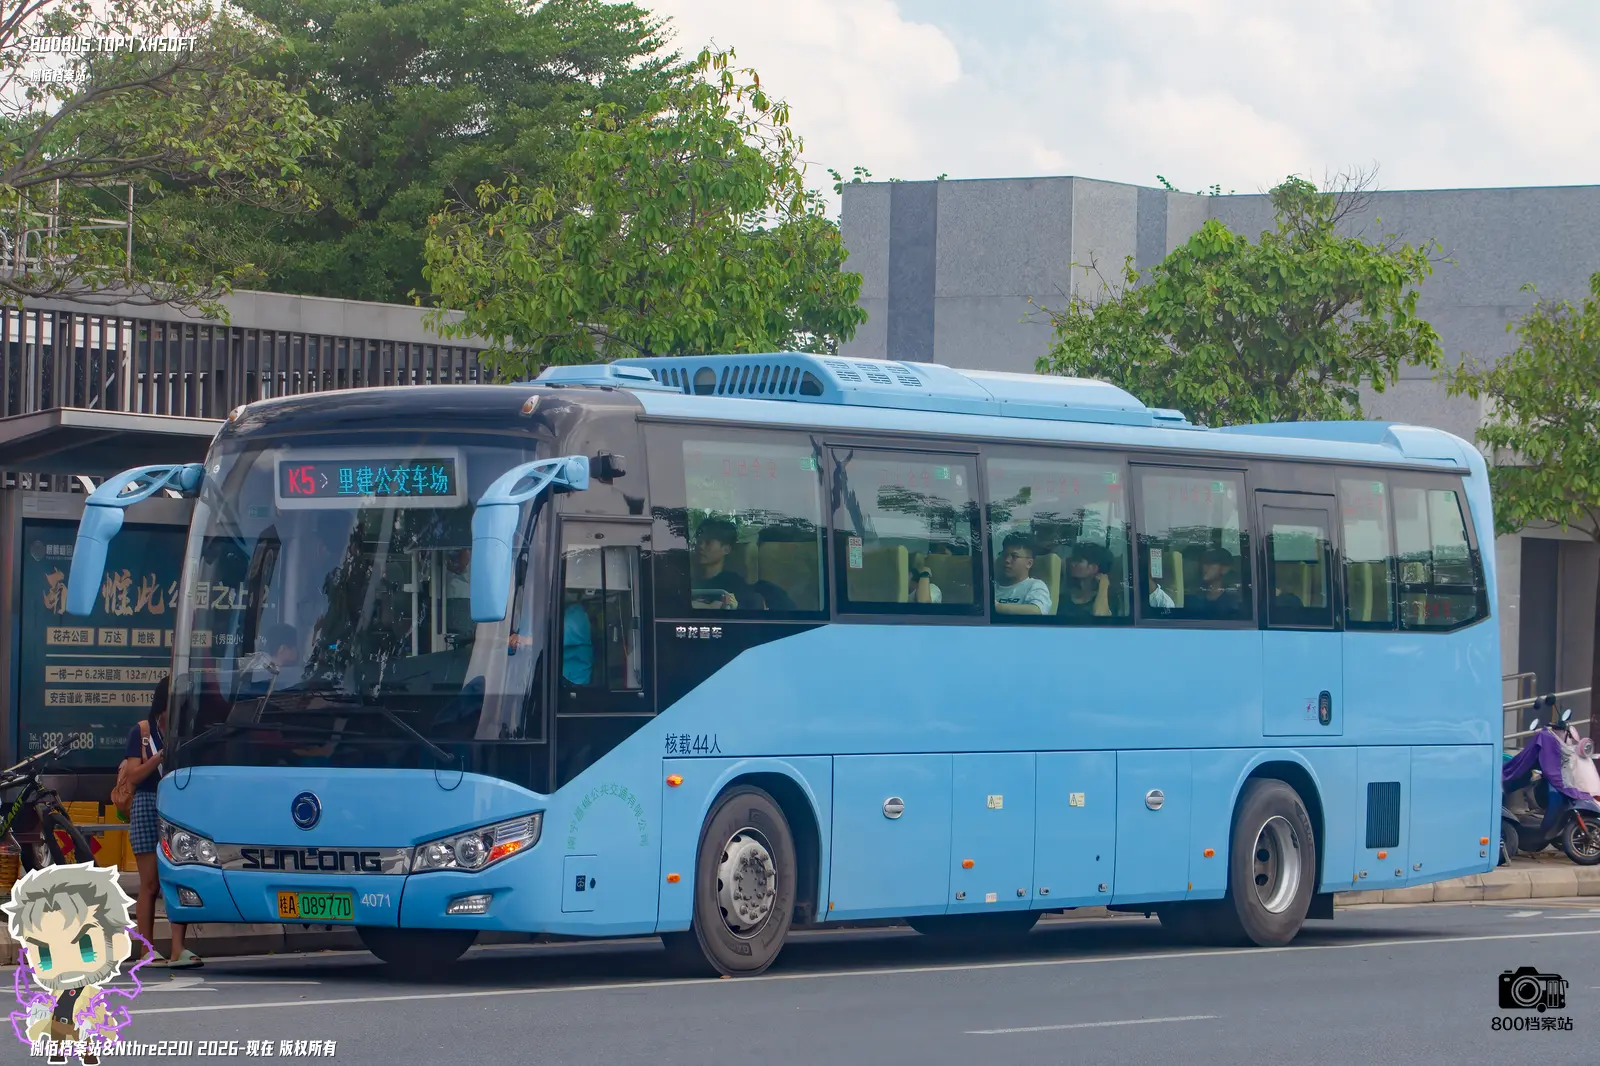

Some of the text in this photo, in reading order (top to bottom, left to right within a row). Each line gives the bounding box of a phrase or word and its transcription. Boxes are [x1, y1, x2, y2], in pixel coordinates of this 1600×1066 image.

[288, 465, 316, 494] K5
[337, 464, 448, 495] 里建公交车场
[53, 630, 89, 643] 花卉公园
[104, 631, 122, 643] 万达
[138, 632, 155, 644] 地铁
[51, 669, 82, 680] 一梯一户
[85, 669, 121, 681] 6.2米层高
[84, 692, 117, 704] 两梯三户
[665, 733, 722, 754] 核载44人
[240, 848, 382, 871] SUNLONG
[302, 896, 351, 916] 08977D
[361, 893, 391, 908] 4071
